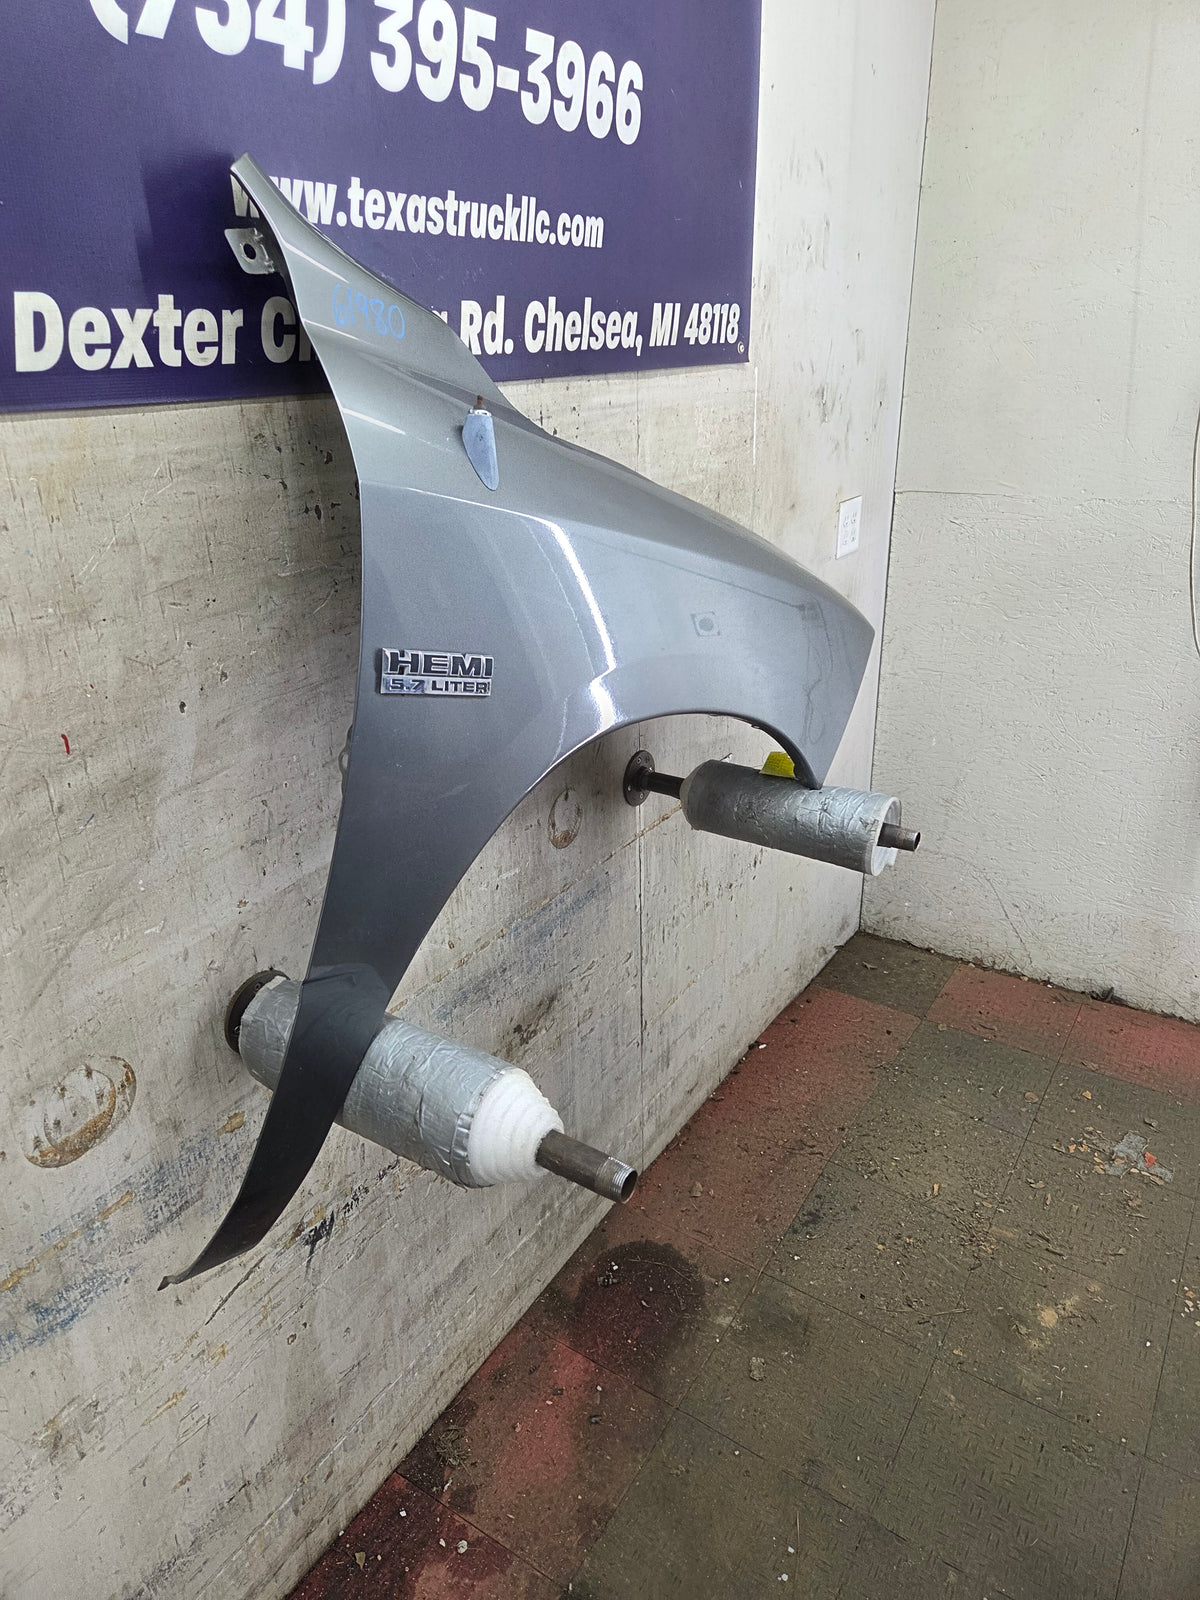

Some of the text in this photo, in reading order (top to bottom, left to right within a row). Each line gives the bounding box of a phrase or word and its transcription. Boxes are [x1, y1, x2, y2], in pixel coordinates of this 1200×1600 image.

[370, 0, 644, 145] 395-3966
[13, 291, 244, 373] Dexter
[332, 284, 405, 339] 61980
[460, 295, 741, 356] Rd. Chelsea, MI 48118
[387, 650, 494, 677] HEMI
[389, 679, 490, 694] 5.7 LITER
